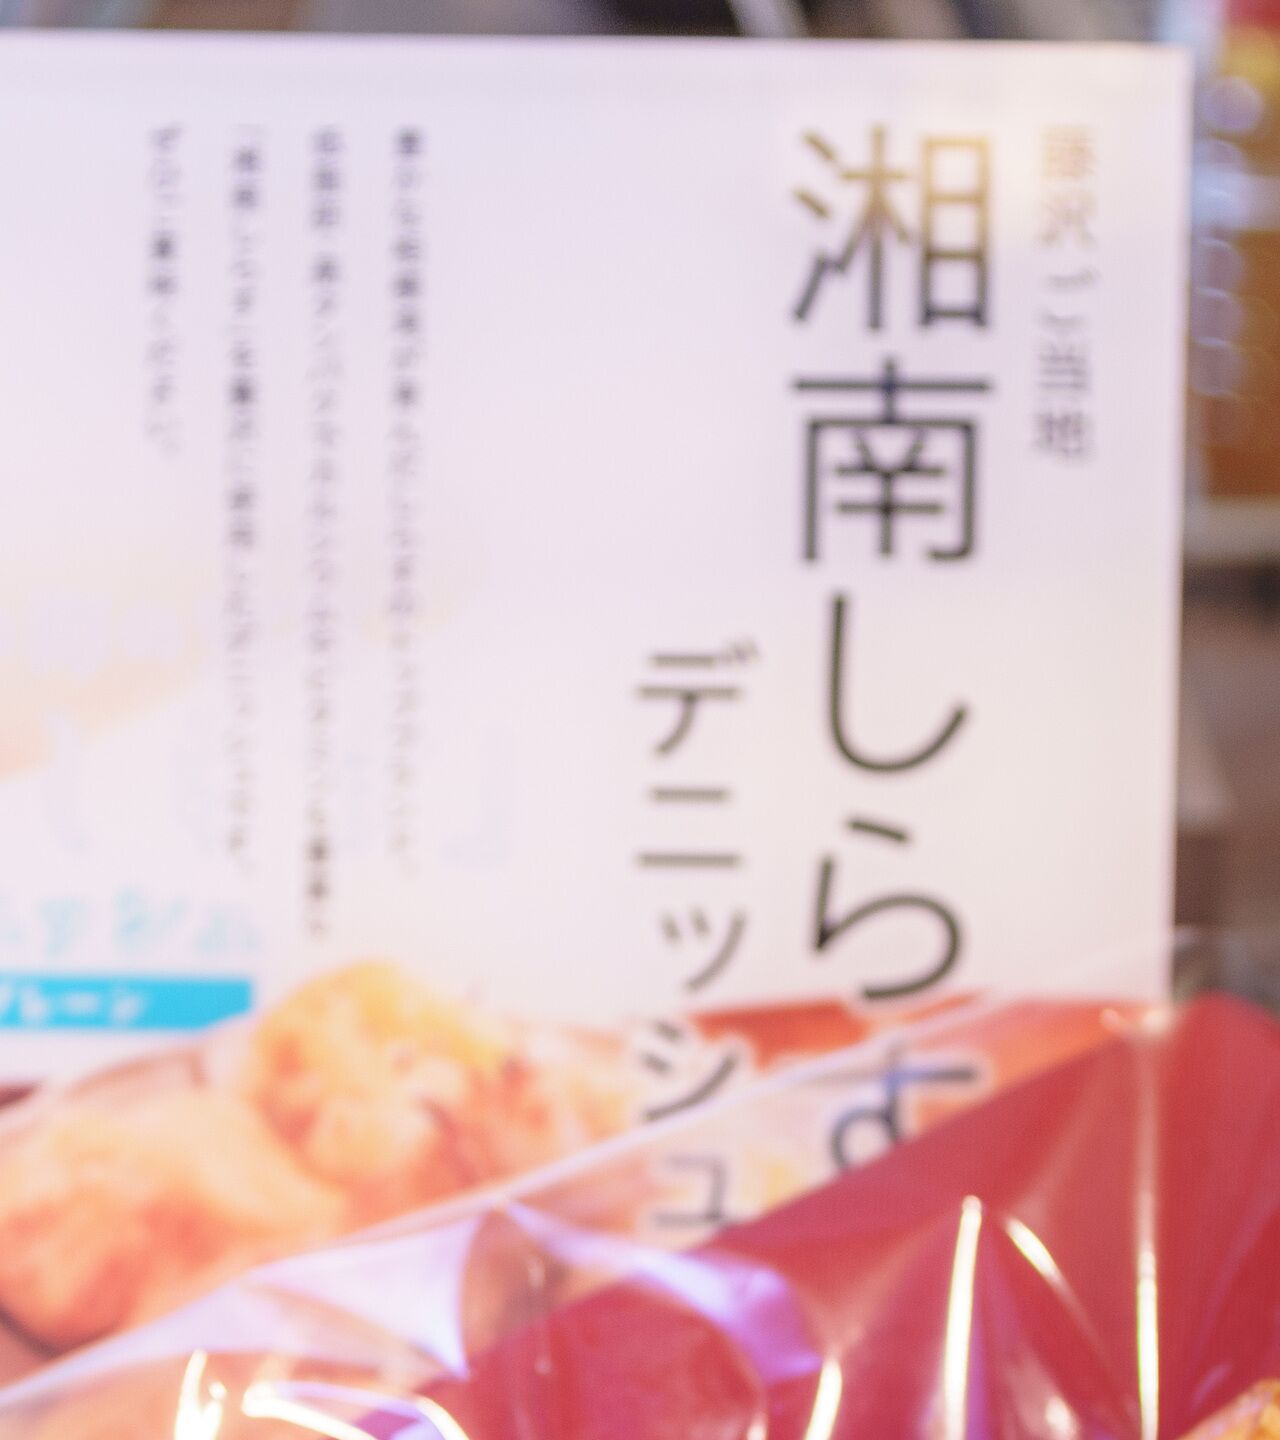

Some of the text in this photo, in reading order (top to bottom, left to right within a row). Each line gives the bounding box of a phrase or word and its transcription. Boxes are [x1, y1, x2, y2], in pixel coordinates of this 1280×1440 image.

[636, 638, 762, 1228] デニッシュ
[786, 122, 994, 1174] 湘南しらす
